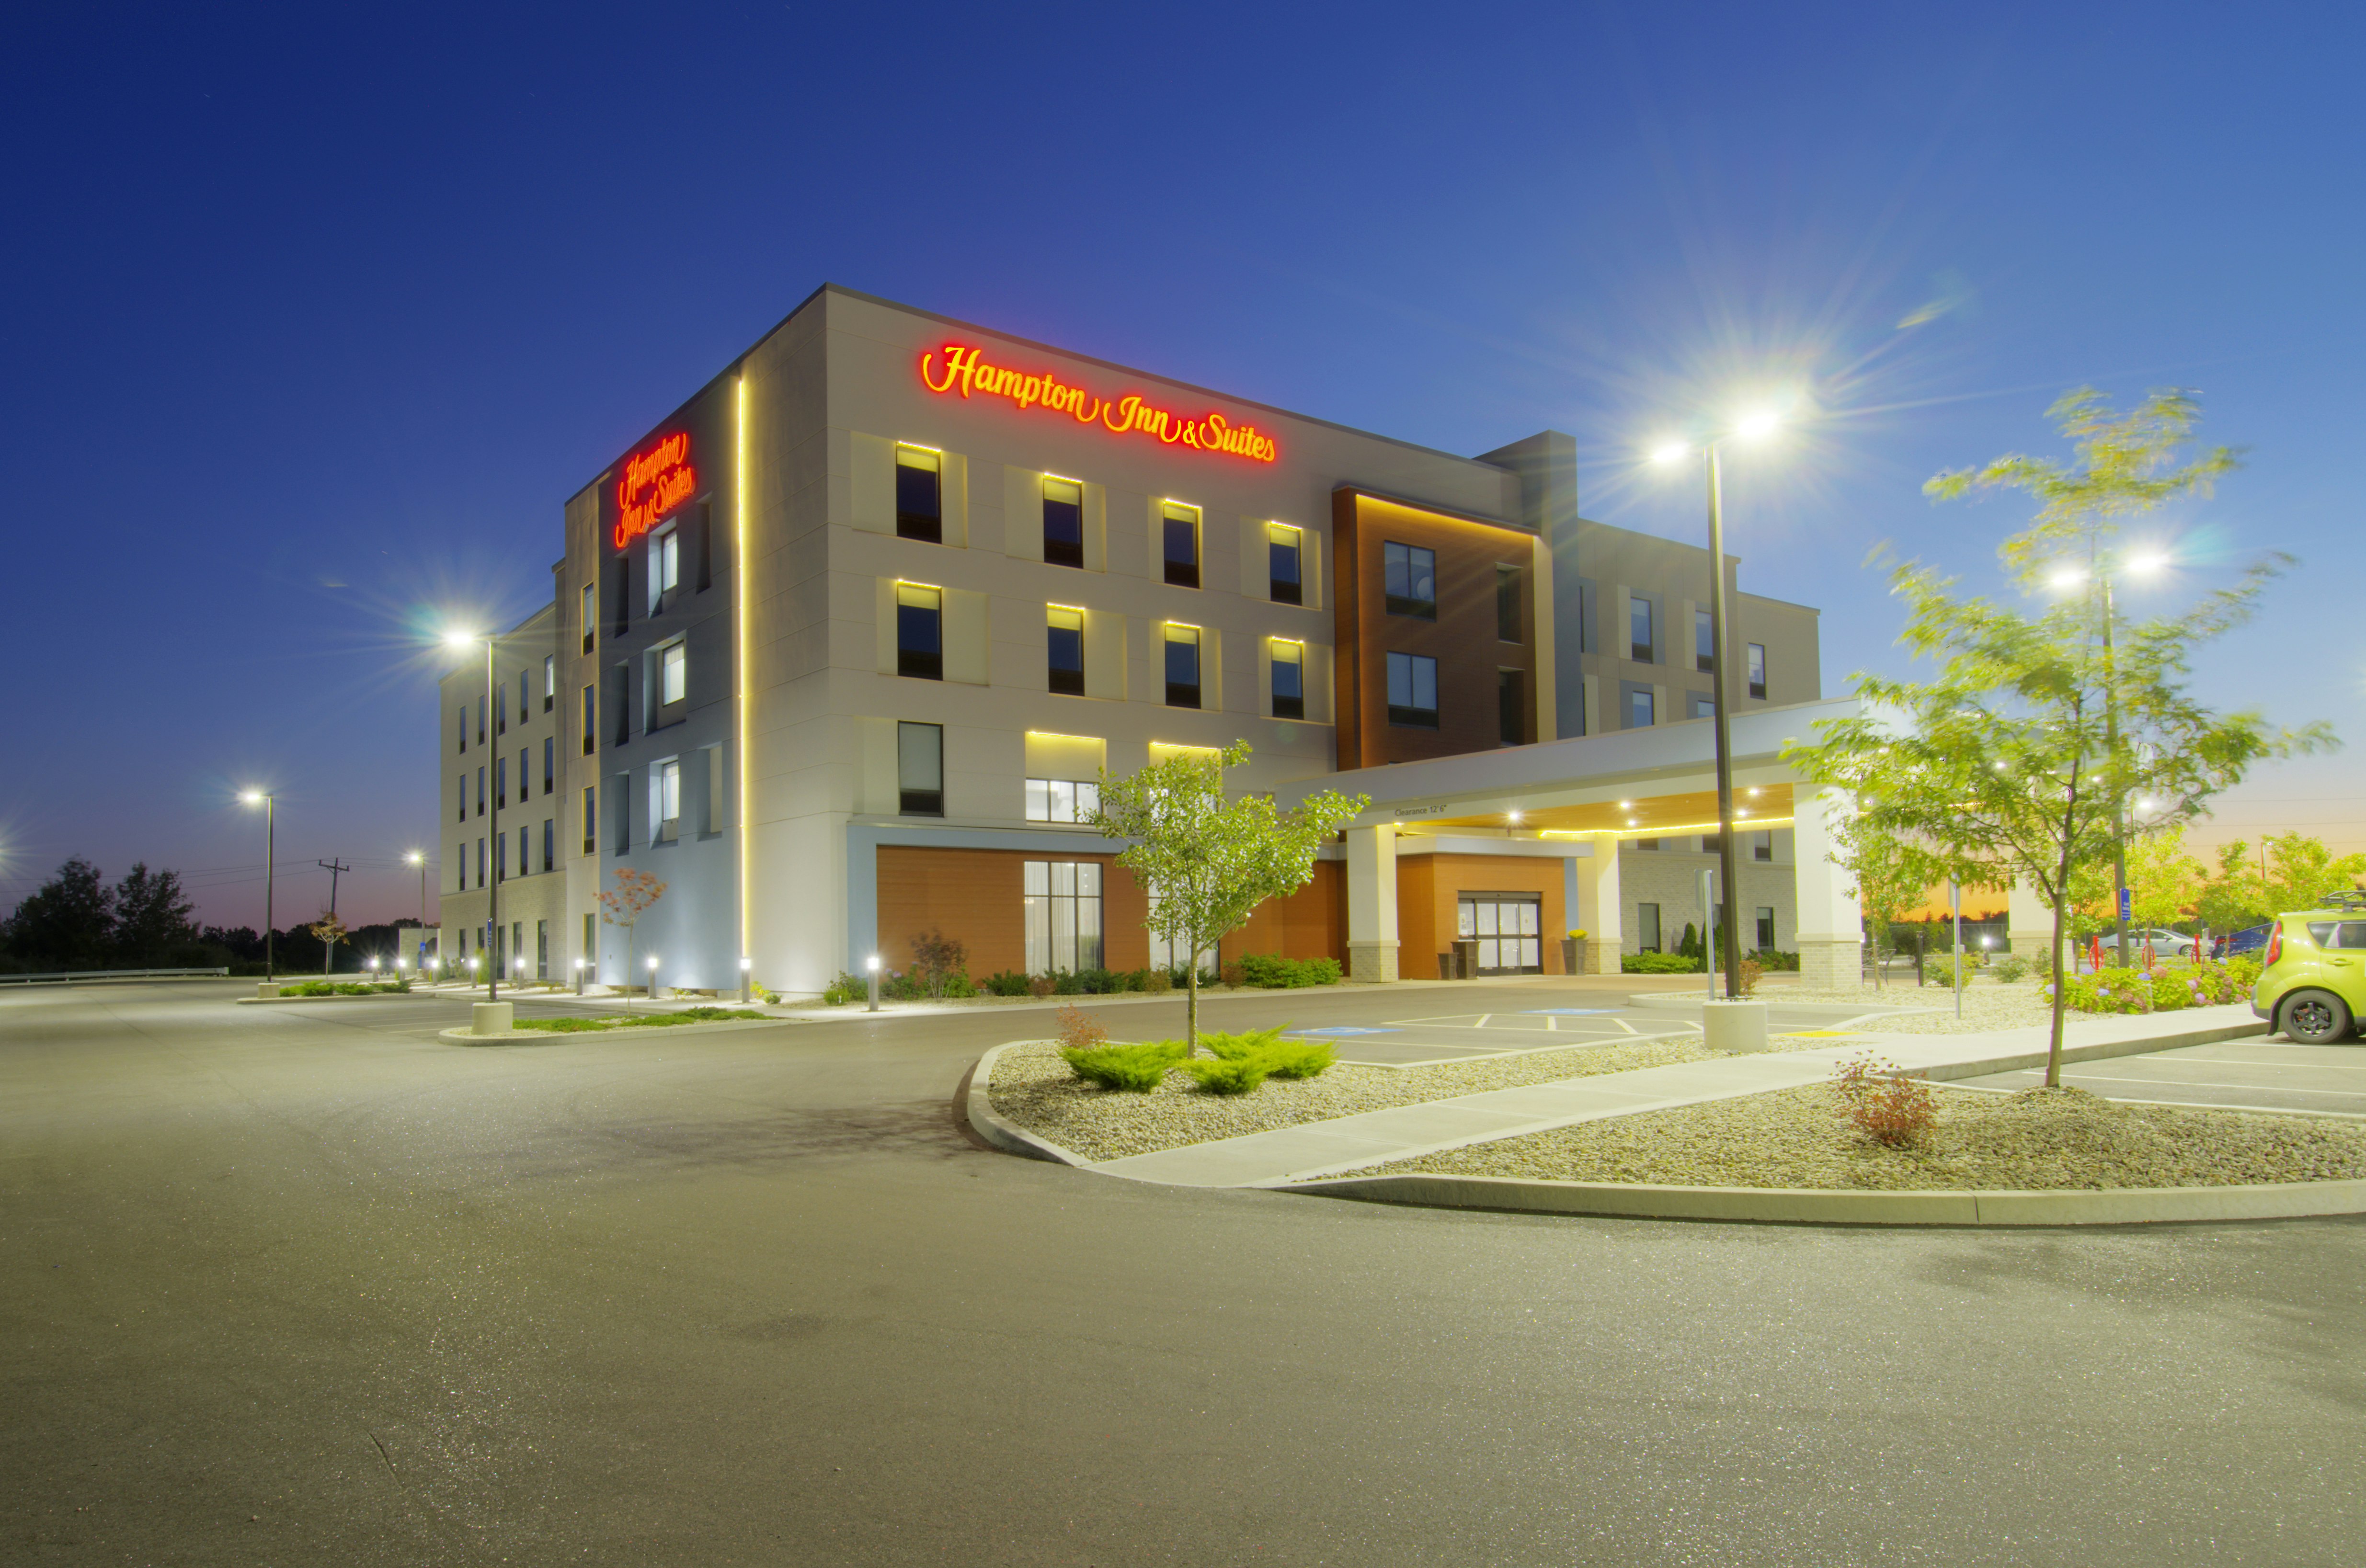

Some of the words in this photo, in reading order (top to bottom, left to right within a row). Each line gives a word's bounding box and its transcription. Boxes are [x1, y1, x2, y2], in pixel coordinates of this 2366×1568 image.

[923, 347, 1099, 422] Hampton
[1103, 397, 1181, 443] Inn
[1182, 421, 1200, 449] &
[1199, 414, 1275, 462] Suites
[616, 504, 647, 547] Inn
[653, 467, 692, 513] Suites
[619, 433, 686, 509] Hampton
